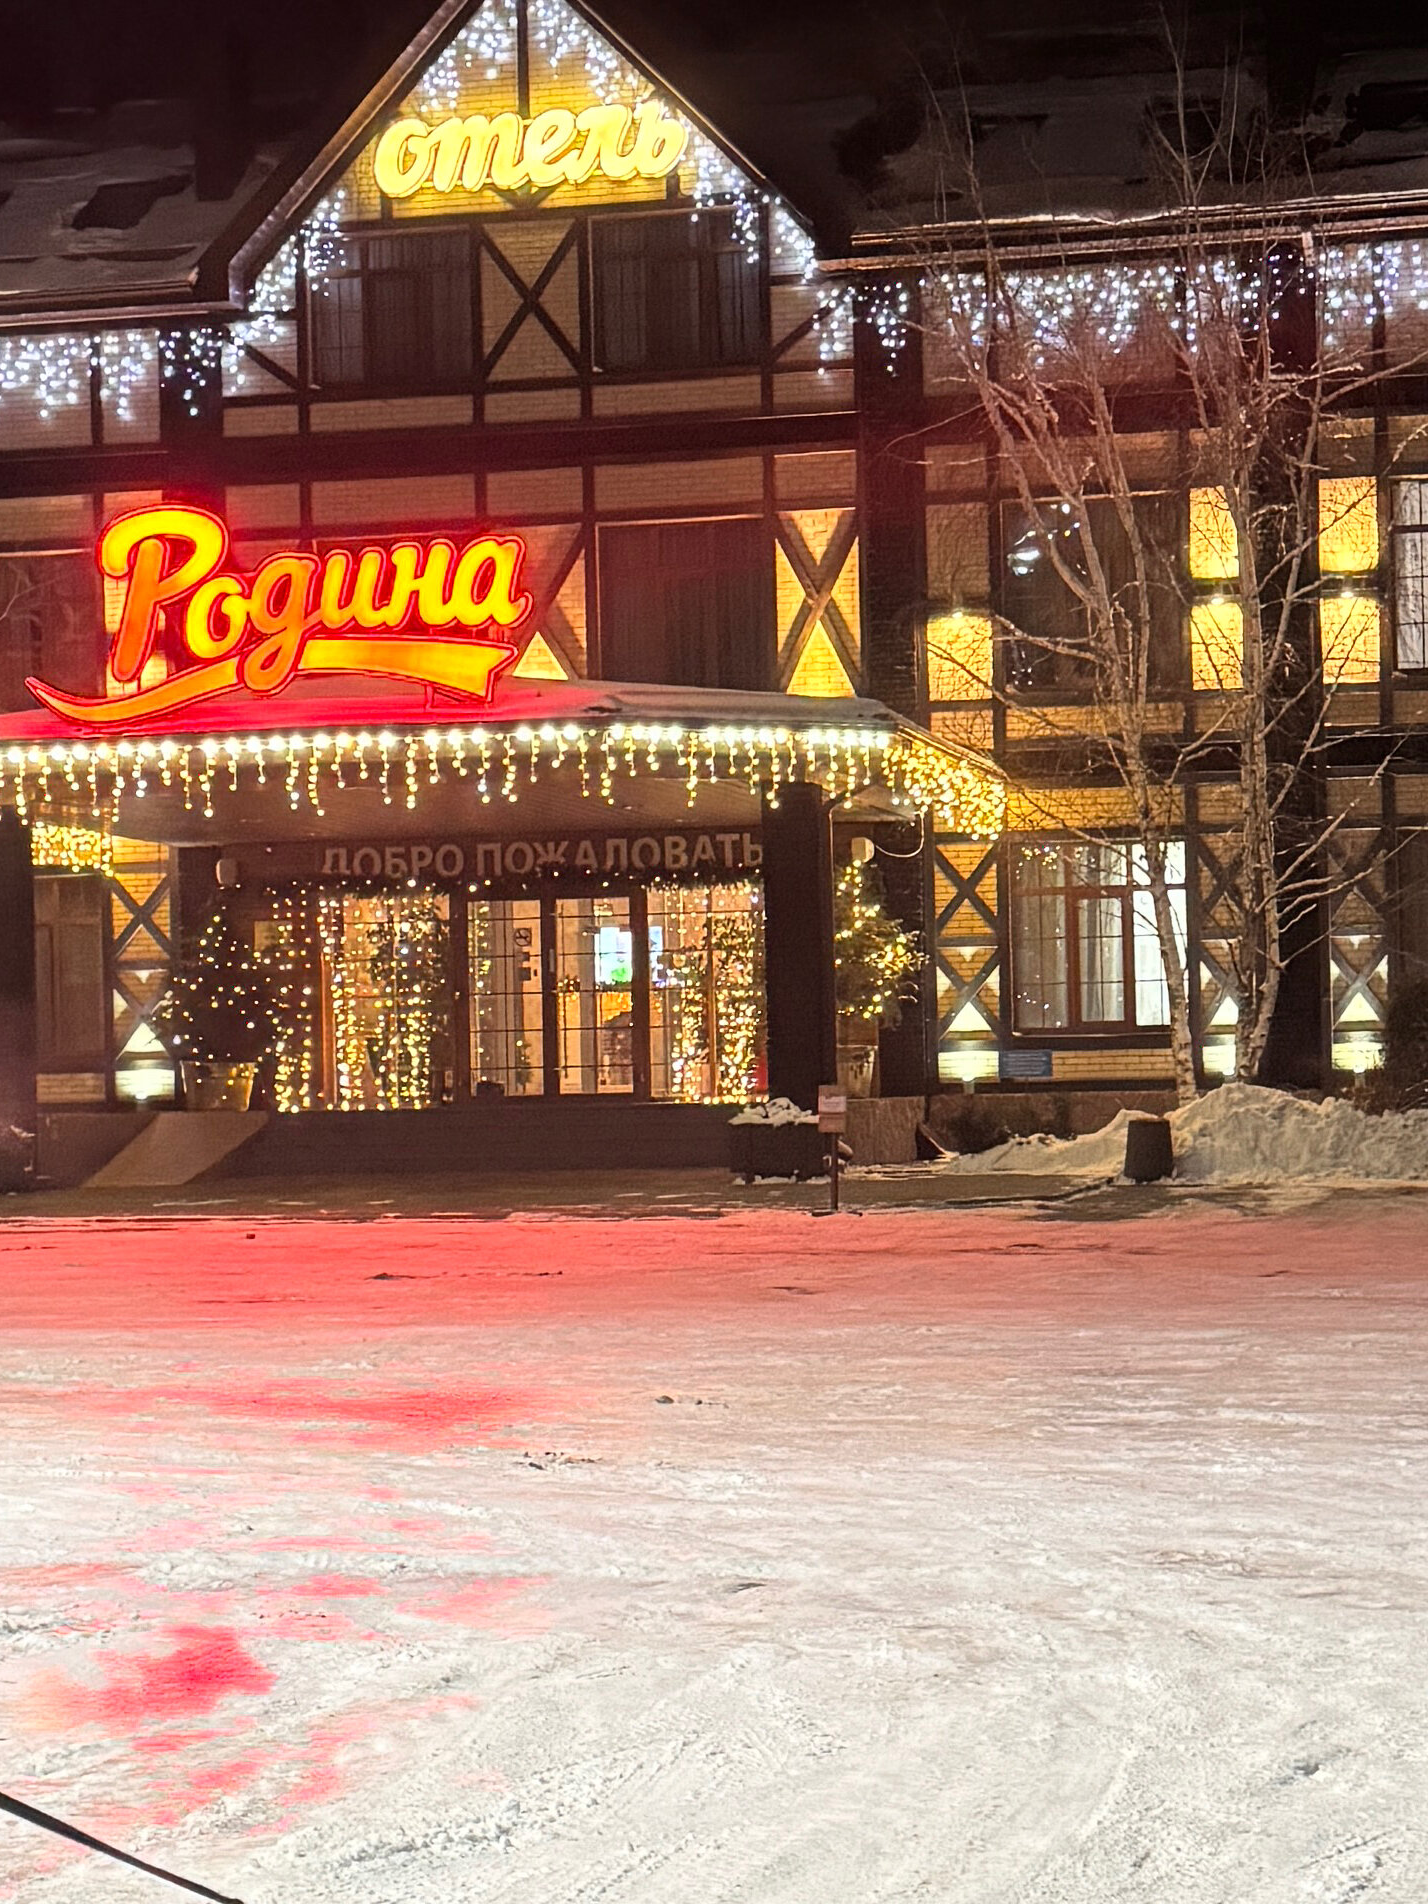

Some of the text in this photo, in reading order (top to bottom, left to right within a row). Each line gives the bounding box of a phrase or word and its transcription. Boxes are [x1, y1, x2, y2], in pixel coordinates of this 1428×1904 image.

[373, 99, 689, 198] отель
[99, 504, 533, 695] Родина
[322, 832, 763, 879] ДОБРО ПОЖАЛОВАТЬ
